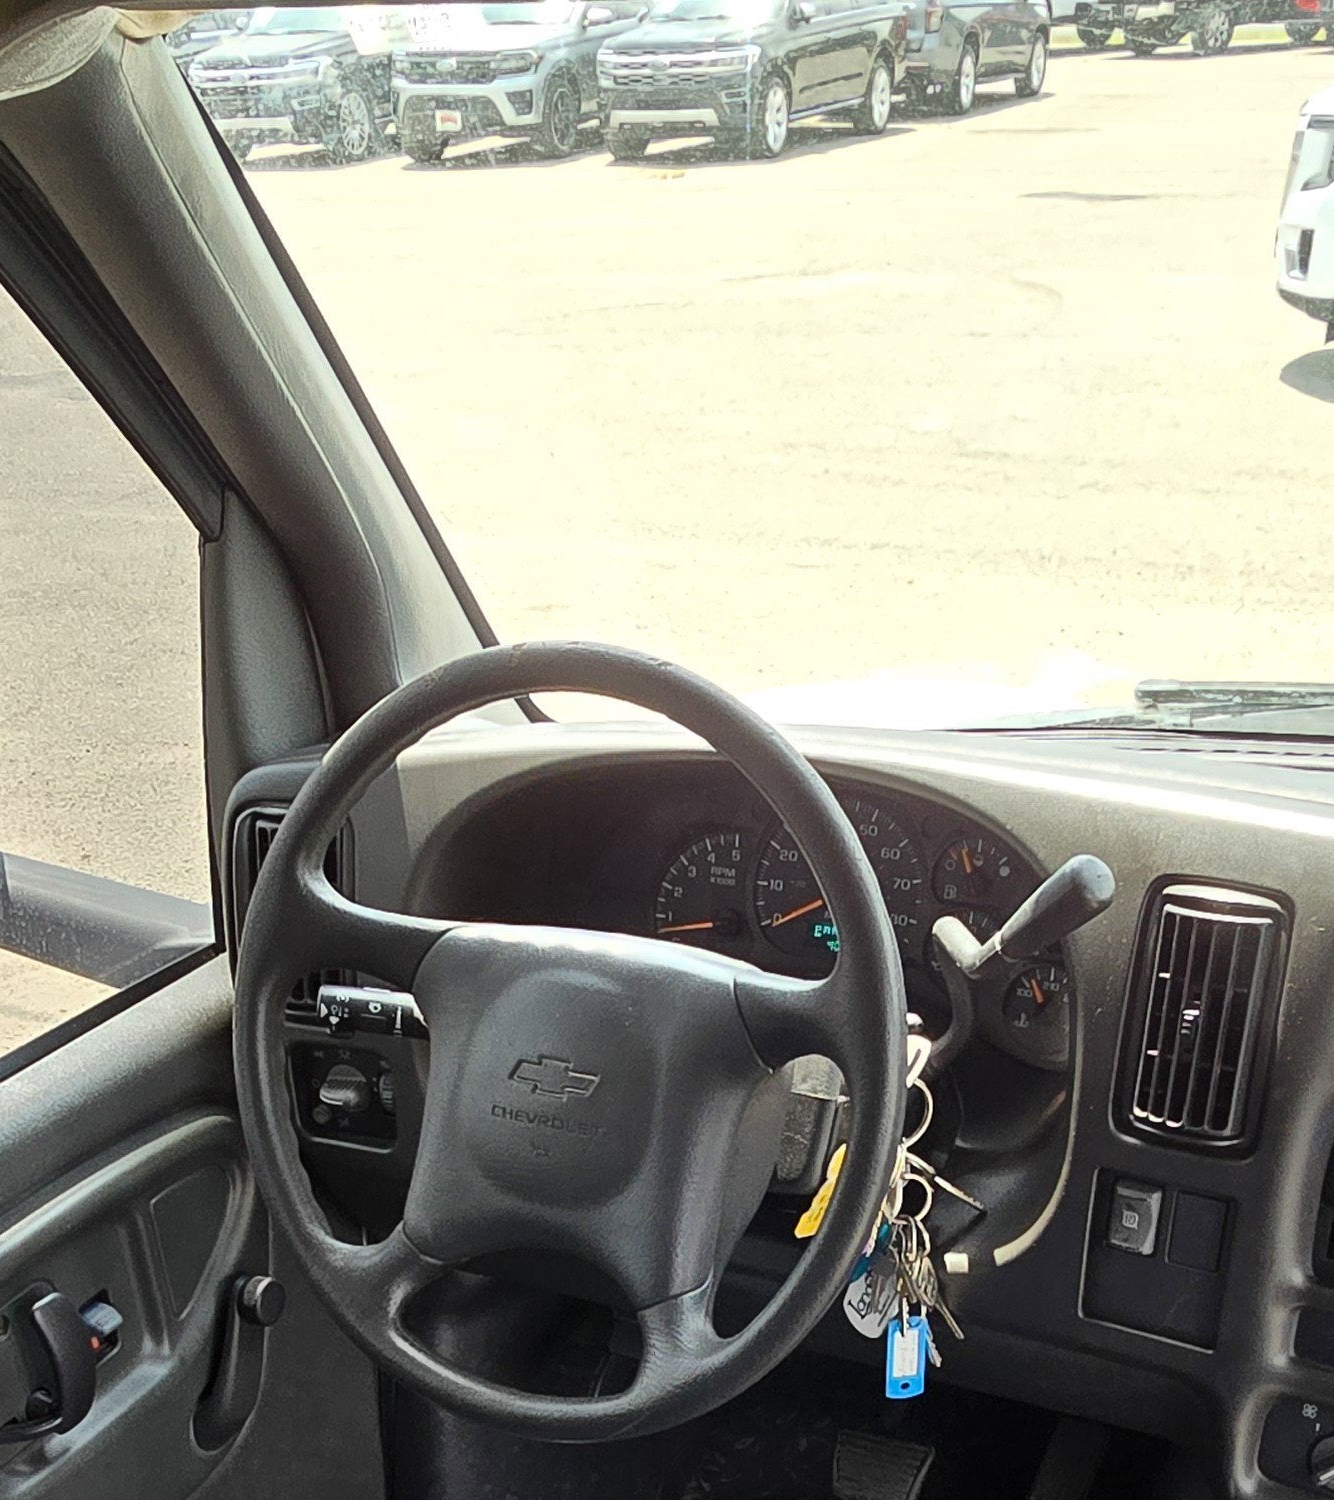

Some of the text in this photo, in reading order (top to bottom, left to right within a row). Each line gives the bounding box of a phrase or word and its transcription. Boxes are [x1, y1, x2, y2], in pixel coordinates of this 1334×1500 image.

[707, 853, 715, 864] 4
[779, 849, 798, 861] 20
[880, 847, 900, 860] 60
[688, 866, 697, 877] 3
[711, 866, 736, 877] RPM
[770, 879, 783, 891] 10
[893, 877, 911, 890] 70
[674, 887, 683, 898] 2
[491, 1104, 604, 1136] CHEVROLET
